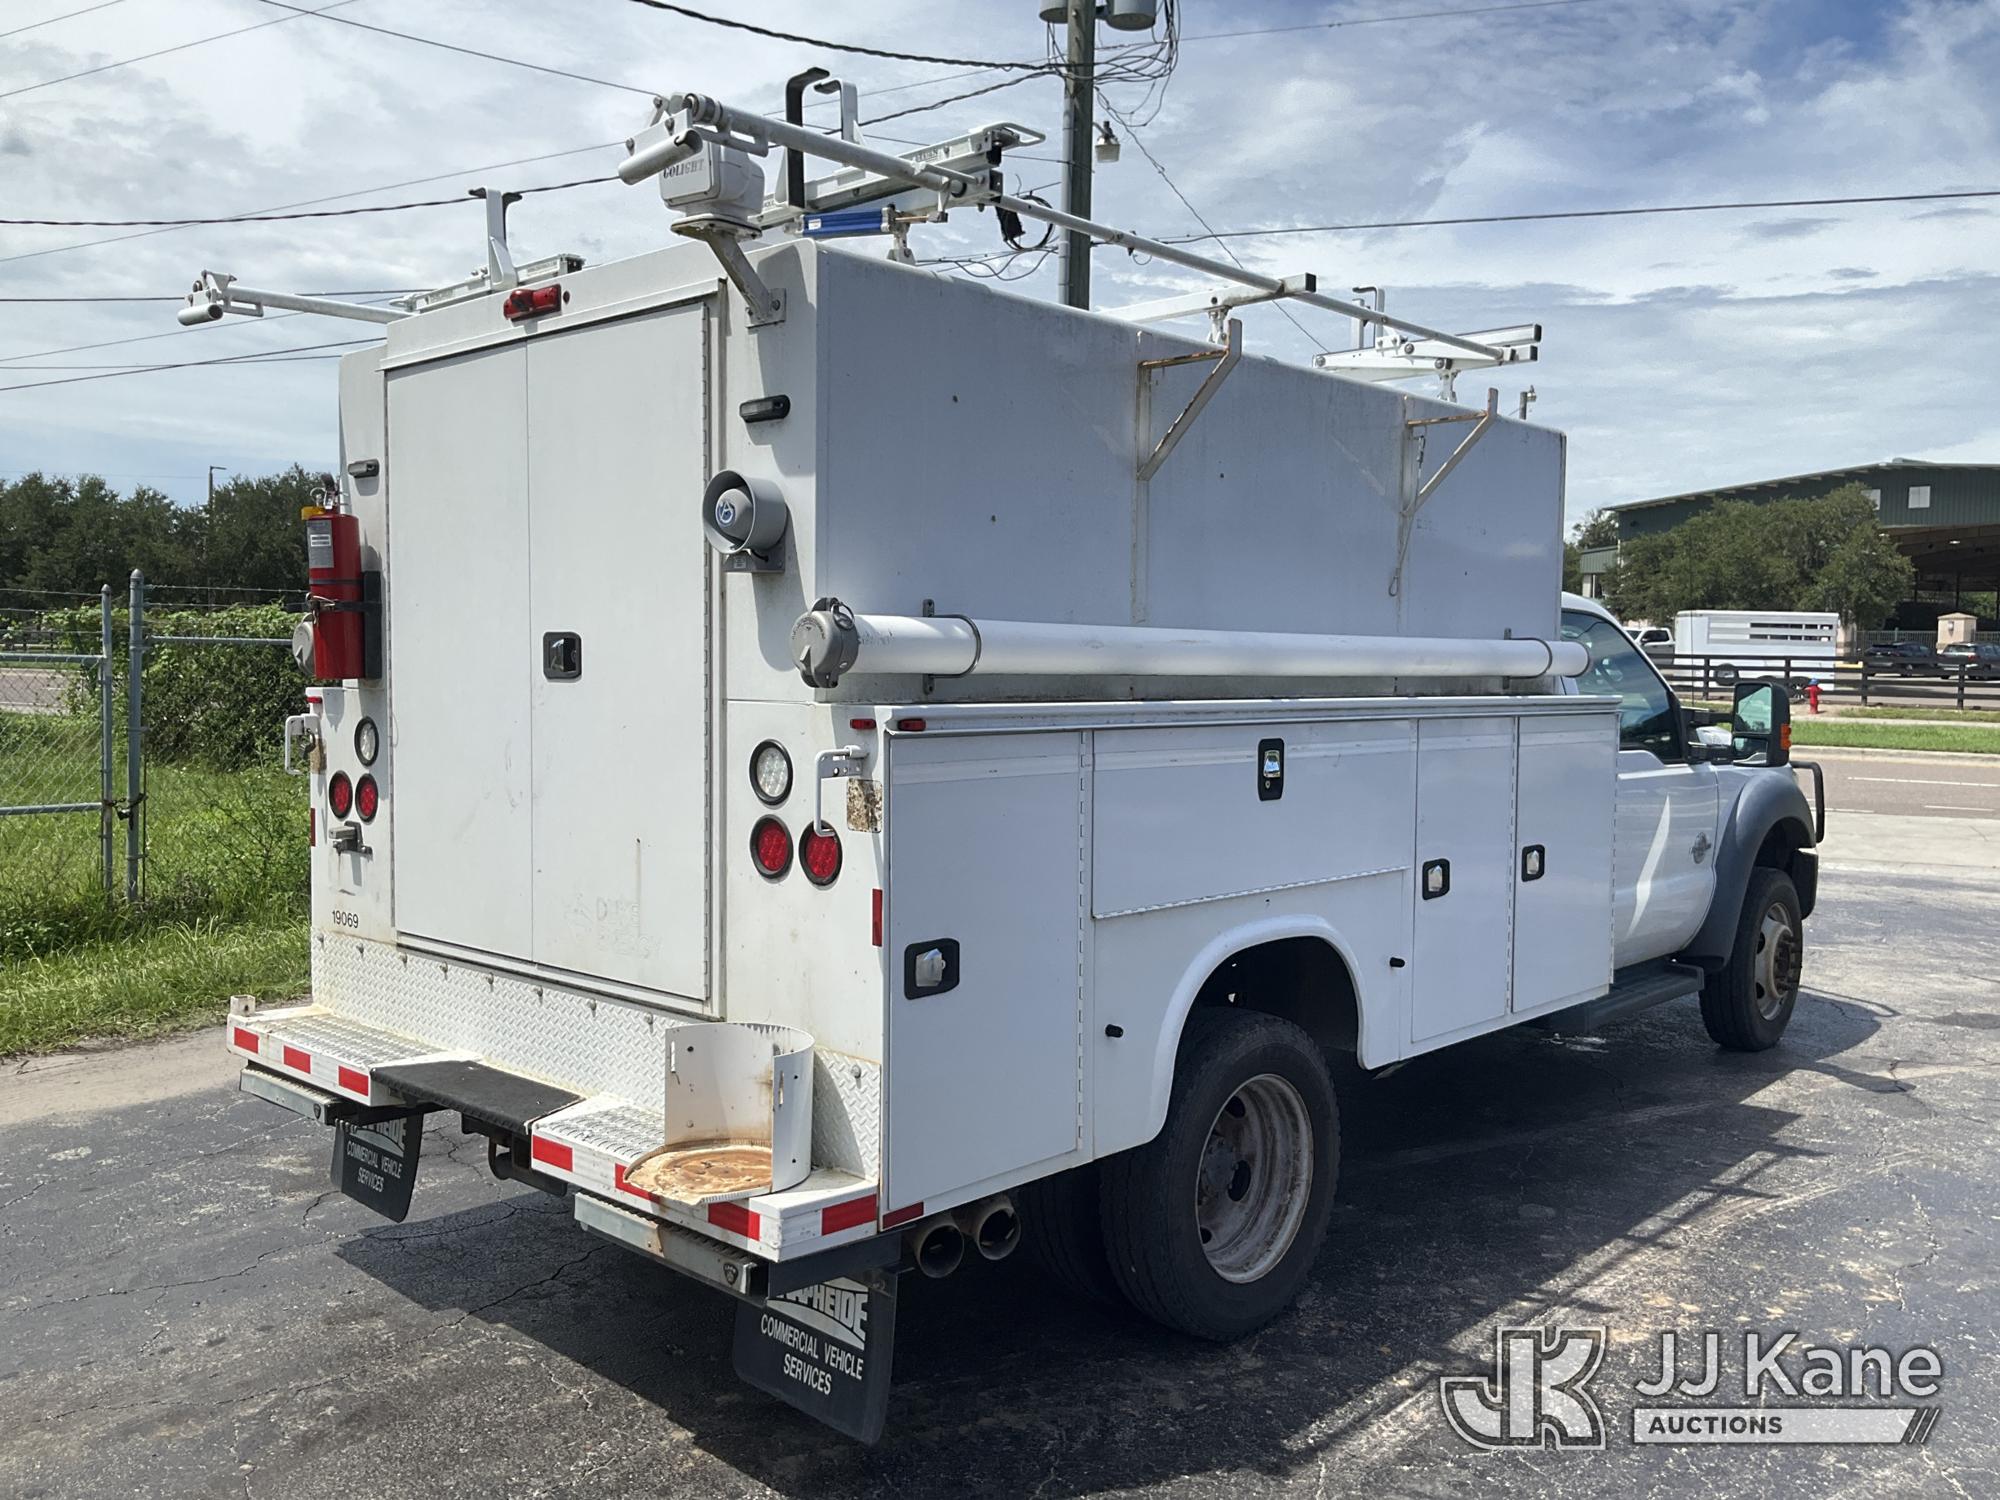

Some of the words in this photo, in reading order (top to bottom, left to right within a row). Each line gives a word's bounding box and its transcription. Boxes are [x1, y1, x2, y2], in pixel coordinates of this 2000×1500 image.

[331, 909, 359, 929] 19069
[346, 1140, 379, 1169] COMMERCIAL
[380, 1154, 403, 1179] VEHICLE
[357, 1166, 384, 1193] SERVICES
[760, 1313, 819, 1360] COMMERCIAL
[824, 1341, 864, 1381] VEHICLE
[783, 1352, 832, 1396] SERVICES
